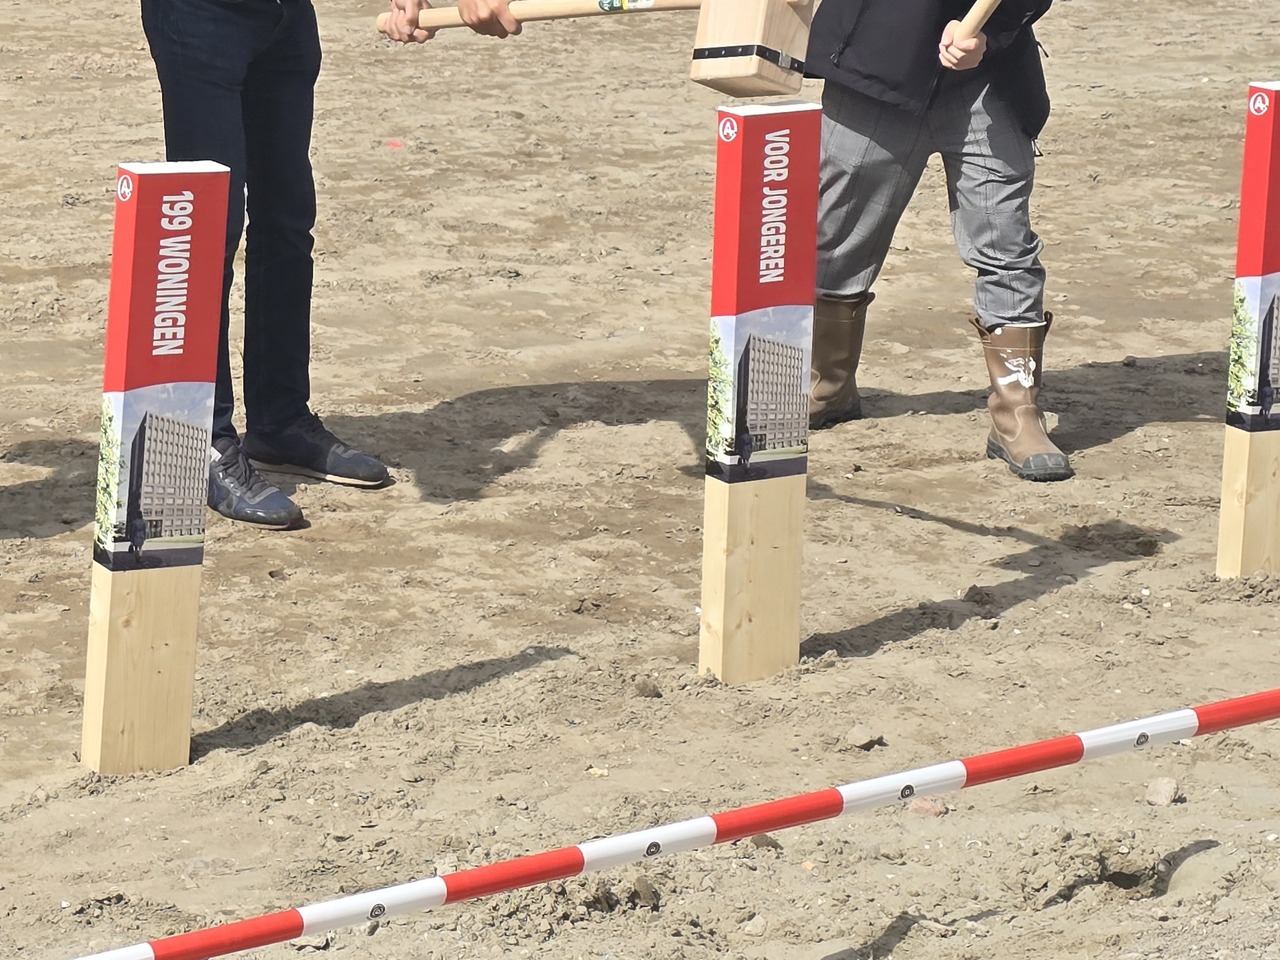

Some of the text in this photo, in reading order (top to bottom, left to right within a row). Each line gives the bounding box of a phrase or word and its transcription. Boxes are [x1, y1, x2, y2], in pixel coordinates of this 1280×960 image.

[152, 190, 195, 356] 199 WONINGEN
[759, 128, 791, 284] VOOR JONGEREN
